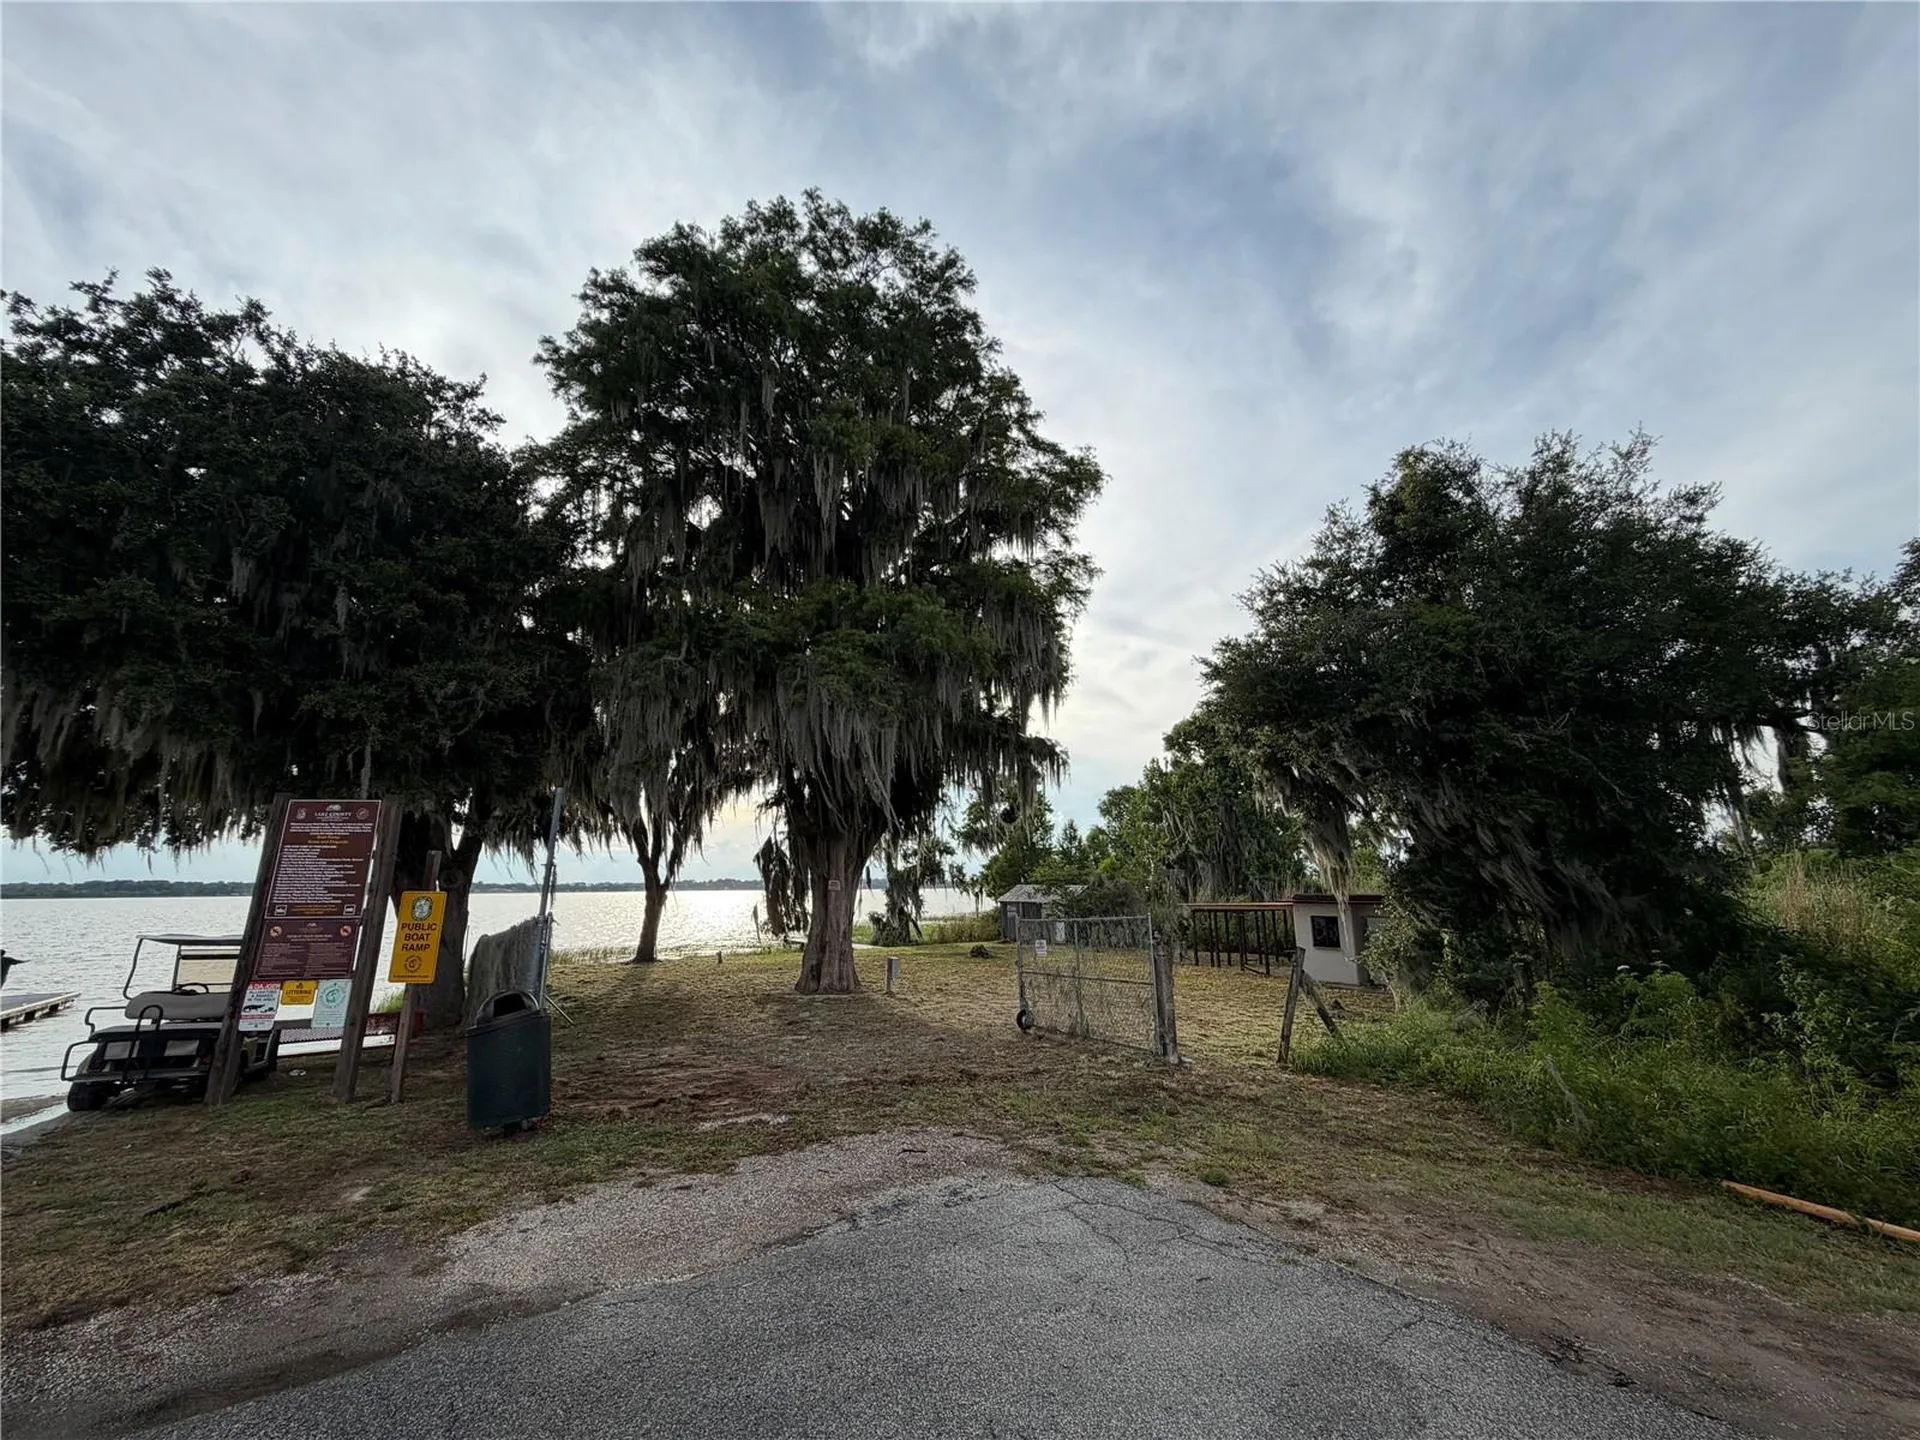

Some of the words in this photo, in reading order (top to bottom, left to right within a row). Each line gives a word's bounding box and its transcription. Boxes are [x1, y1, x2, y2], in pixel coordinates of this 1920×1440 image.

[401, 922, 437, 931] PUBLIC
[404, 933, 430, 942] BOAT
[401, 944, 430, 952] RAMP
